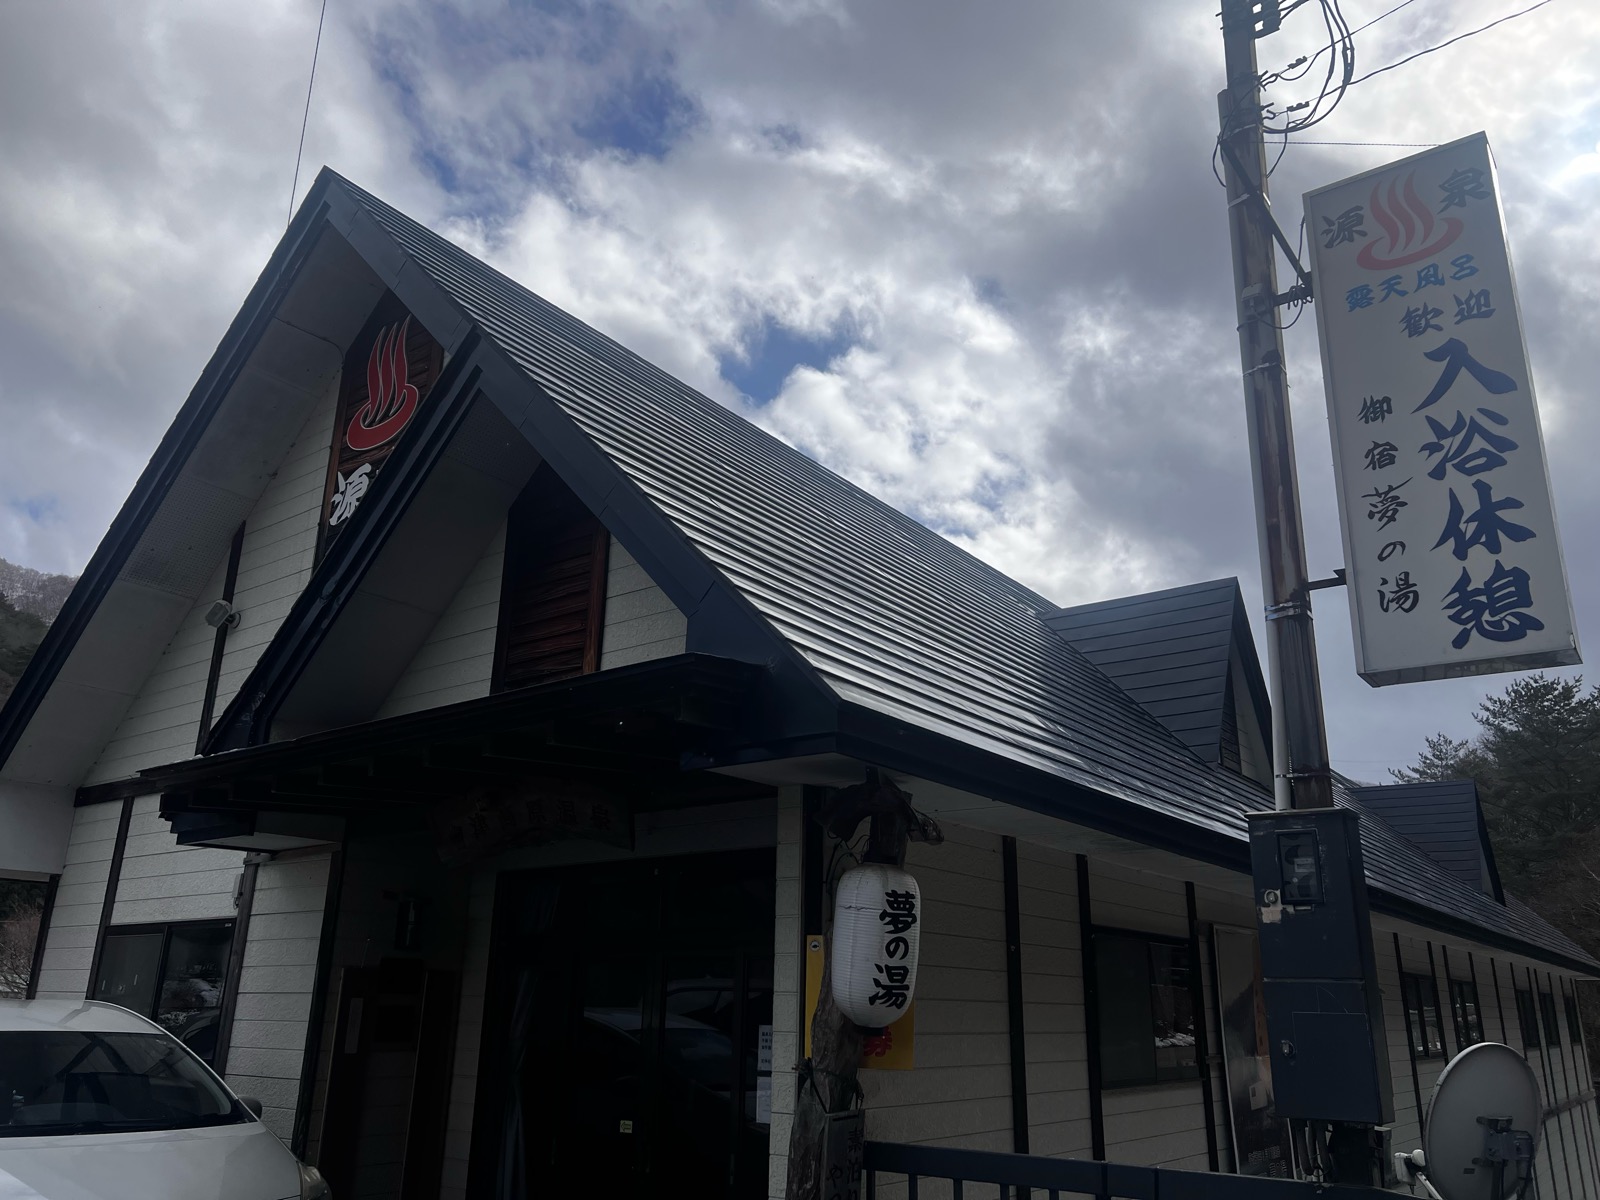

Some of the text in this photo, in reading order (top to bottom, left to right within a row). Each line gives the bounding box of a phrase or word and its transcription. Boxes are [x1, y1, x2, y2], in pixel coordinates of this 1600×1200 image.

[1320, 167, 1492, 249] 源 泉
[1345, 253, 1480, 312] 露天風呂
[1410, 337, 1545, 650] 入浴休憩
[869, 889, 918, 1010] 夢の湯
